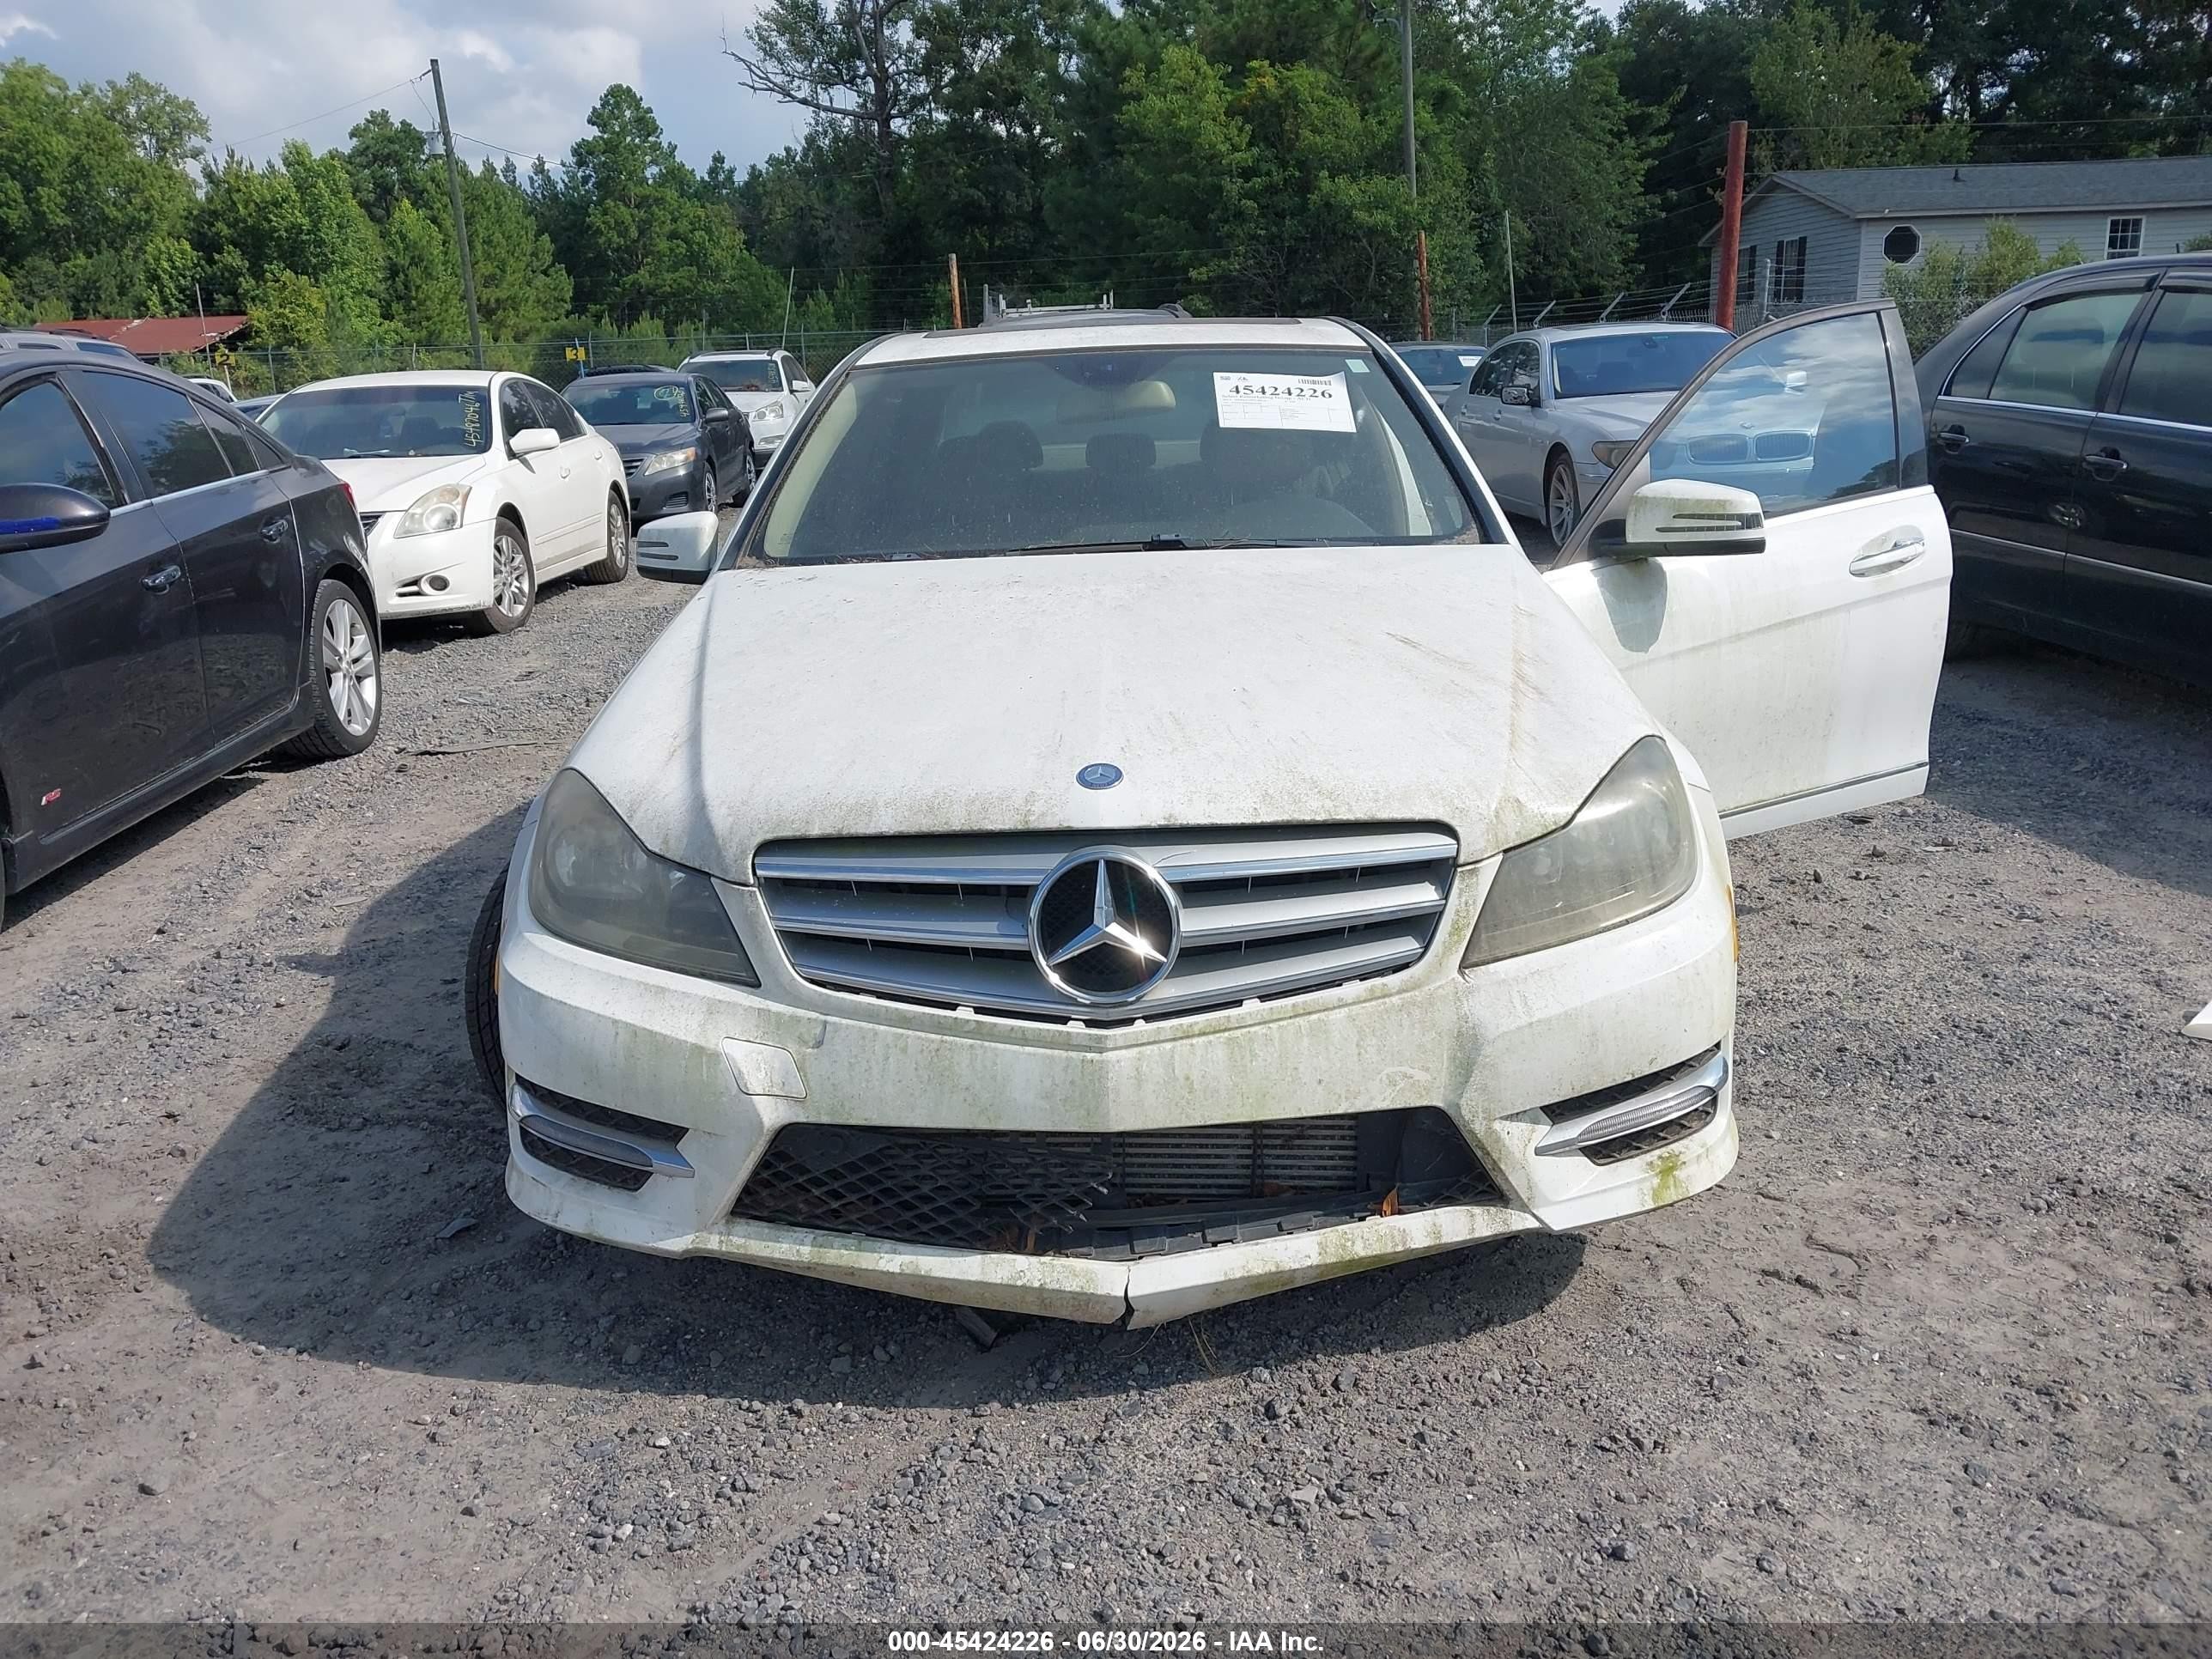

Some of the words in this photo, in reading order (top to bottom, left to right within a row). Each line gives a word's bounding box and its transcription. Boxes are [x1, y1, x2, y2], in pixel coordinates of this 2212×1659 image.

[218, 353, 232, 366] 2
[570, 348, 579, 361] 3
[1229, 384, 1334, 399] 45424226
